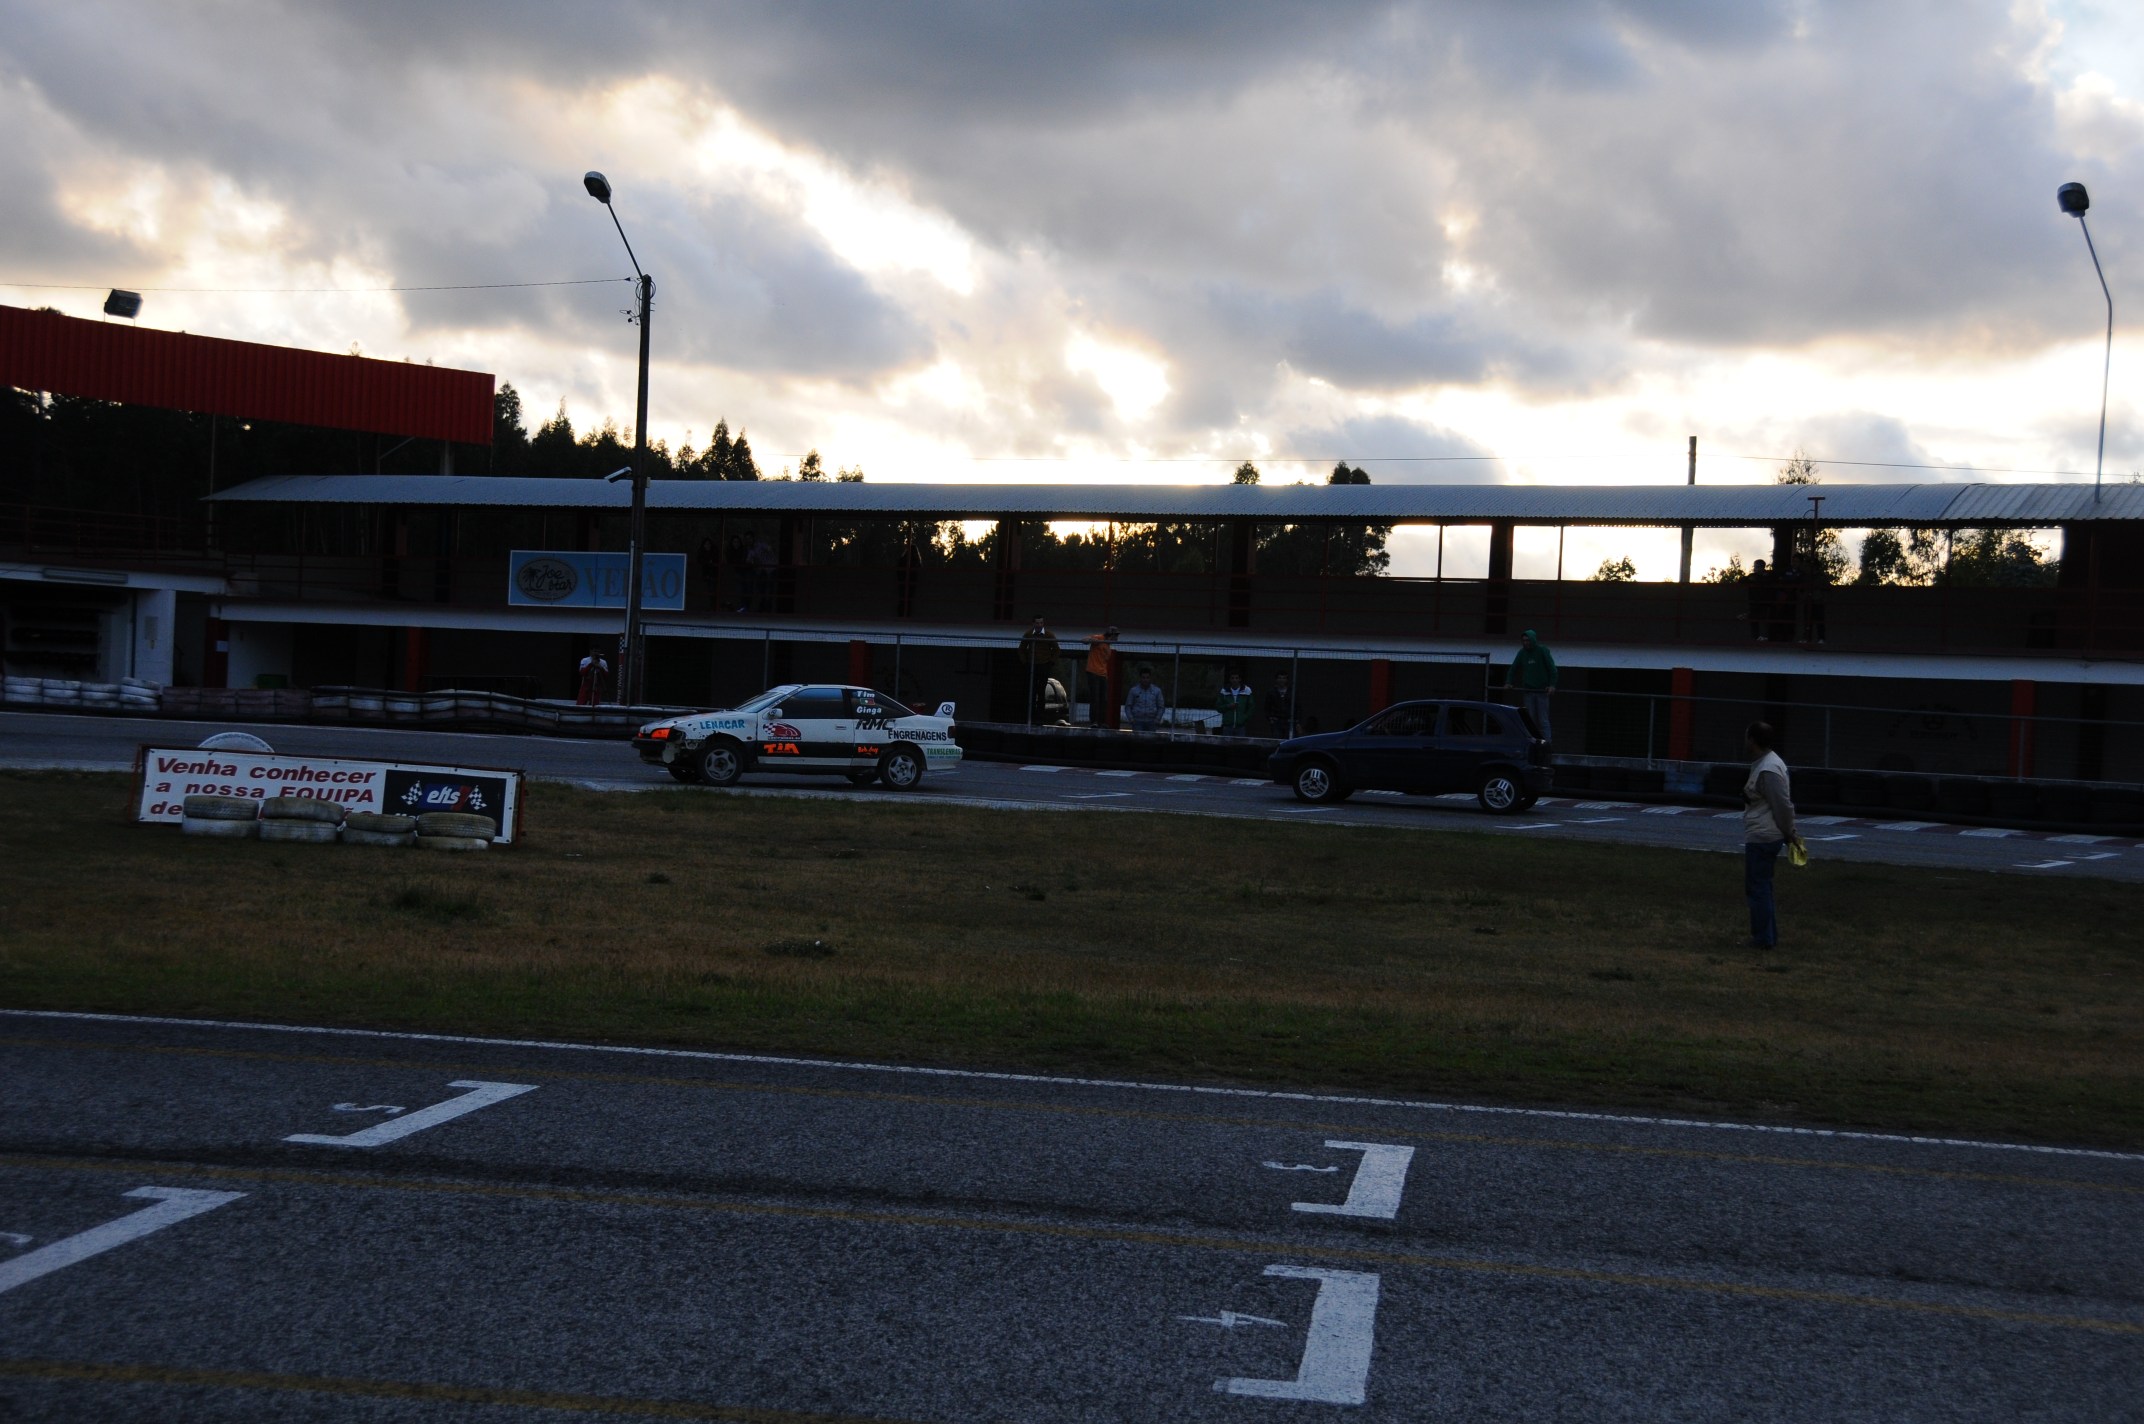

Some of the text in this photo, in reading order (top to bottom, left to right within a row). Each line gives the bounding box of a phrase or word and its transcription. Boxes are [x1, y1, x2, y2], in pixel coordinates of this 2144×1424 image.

[856, 705, 882, 715] Ginga
[699, 719, 745, 730] LENACAR
[855, 719, 895, 731] RMC
[157, 757, 377, 784] Venha conhecer
[156, 782, 374, 803] a nossa EQUIPA
